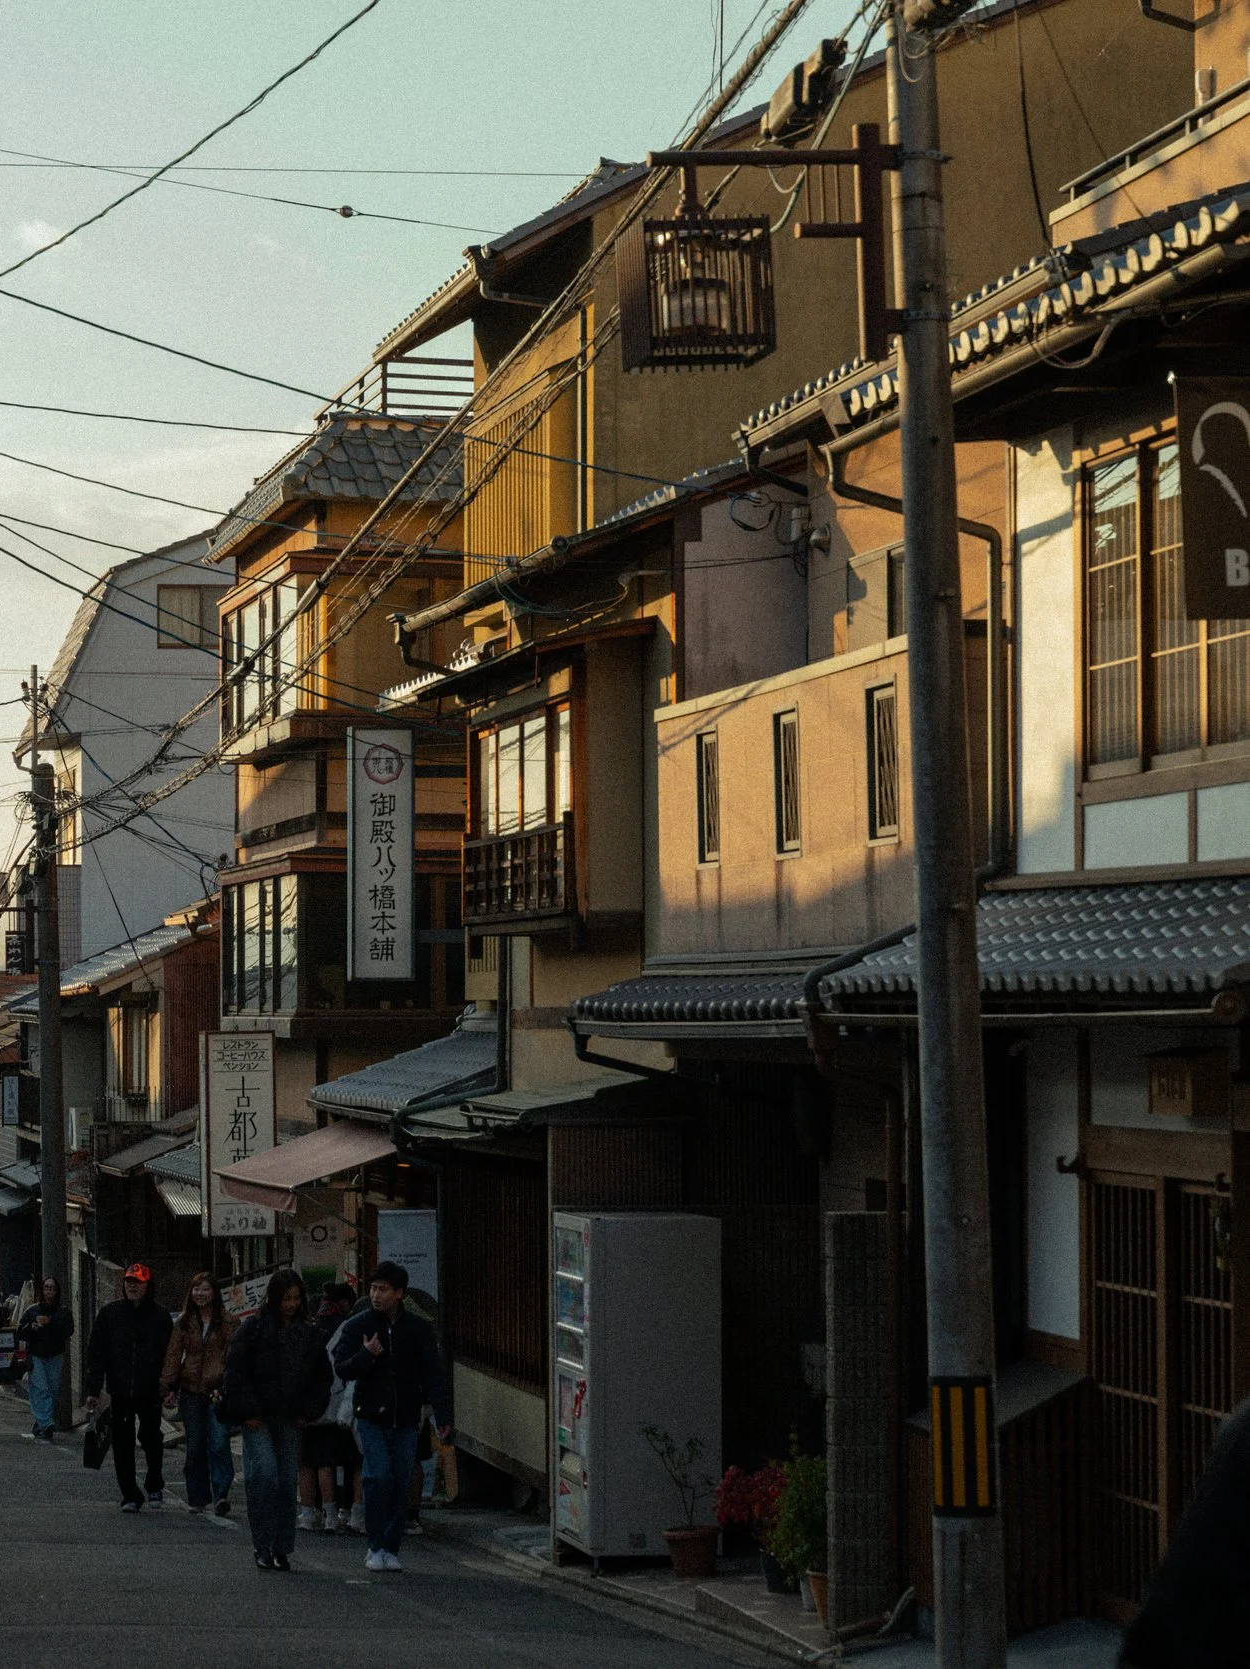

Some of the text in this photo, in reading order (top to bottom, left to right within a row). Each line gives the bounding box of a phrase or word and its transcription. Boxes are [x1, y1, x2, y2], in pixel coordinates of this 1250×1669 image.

[223, 1041, 258, 1049] レストラン
[217, 1051, 266, 1061] コーヒーハウス
[223, 1062, 258, 1070] ペンション
